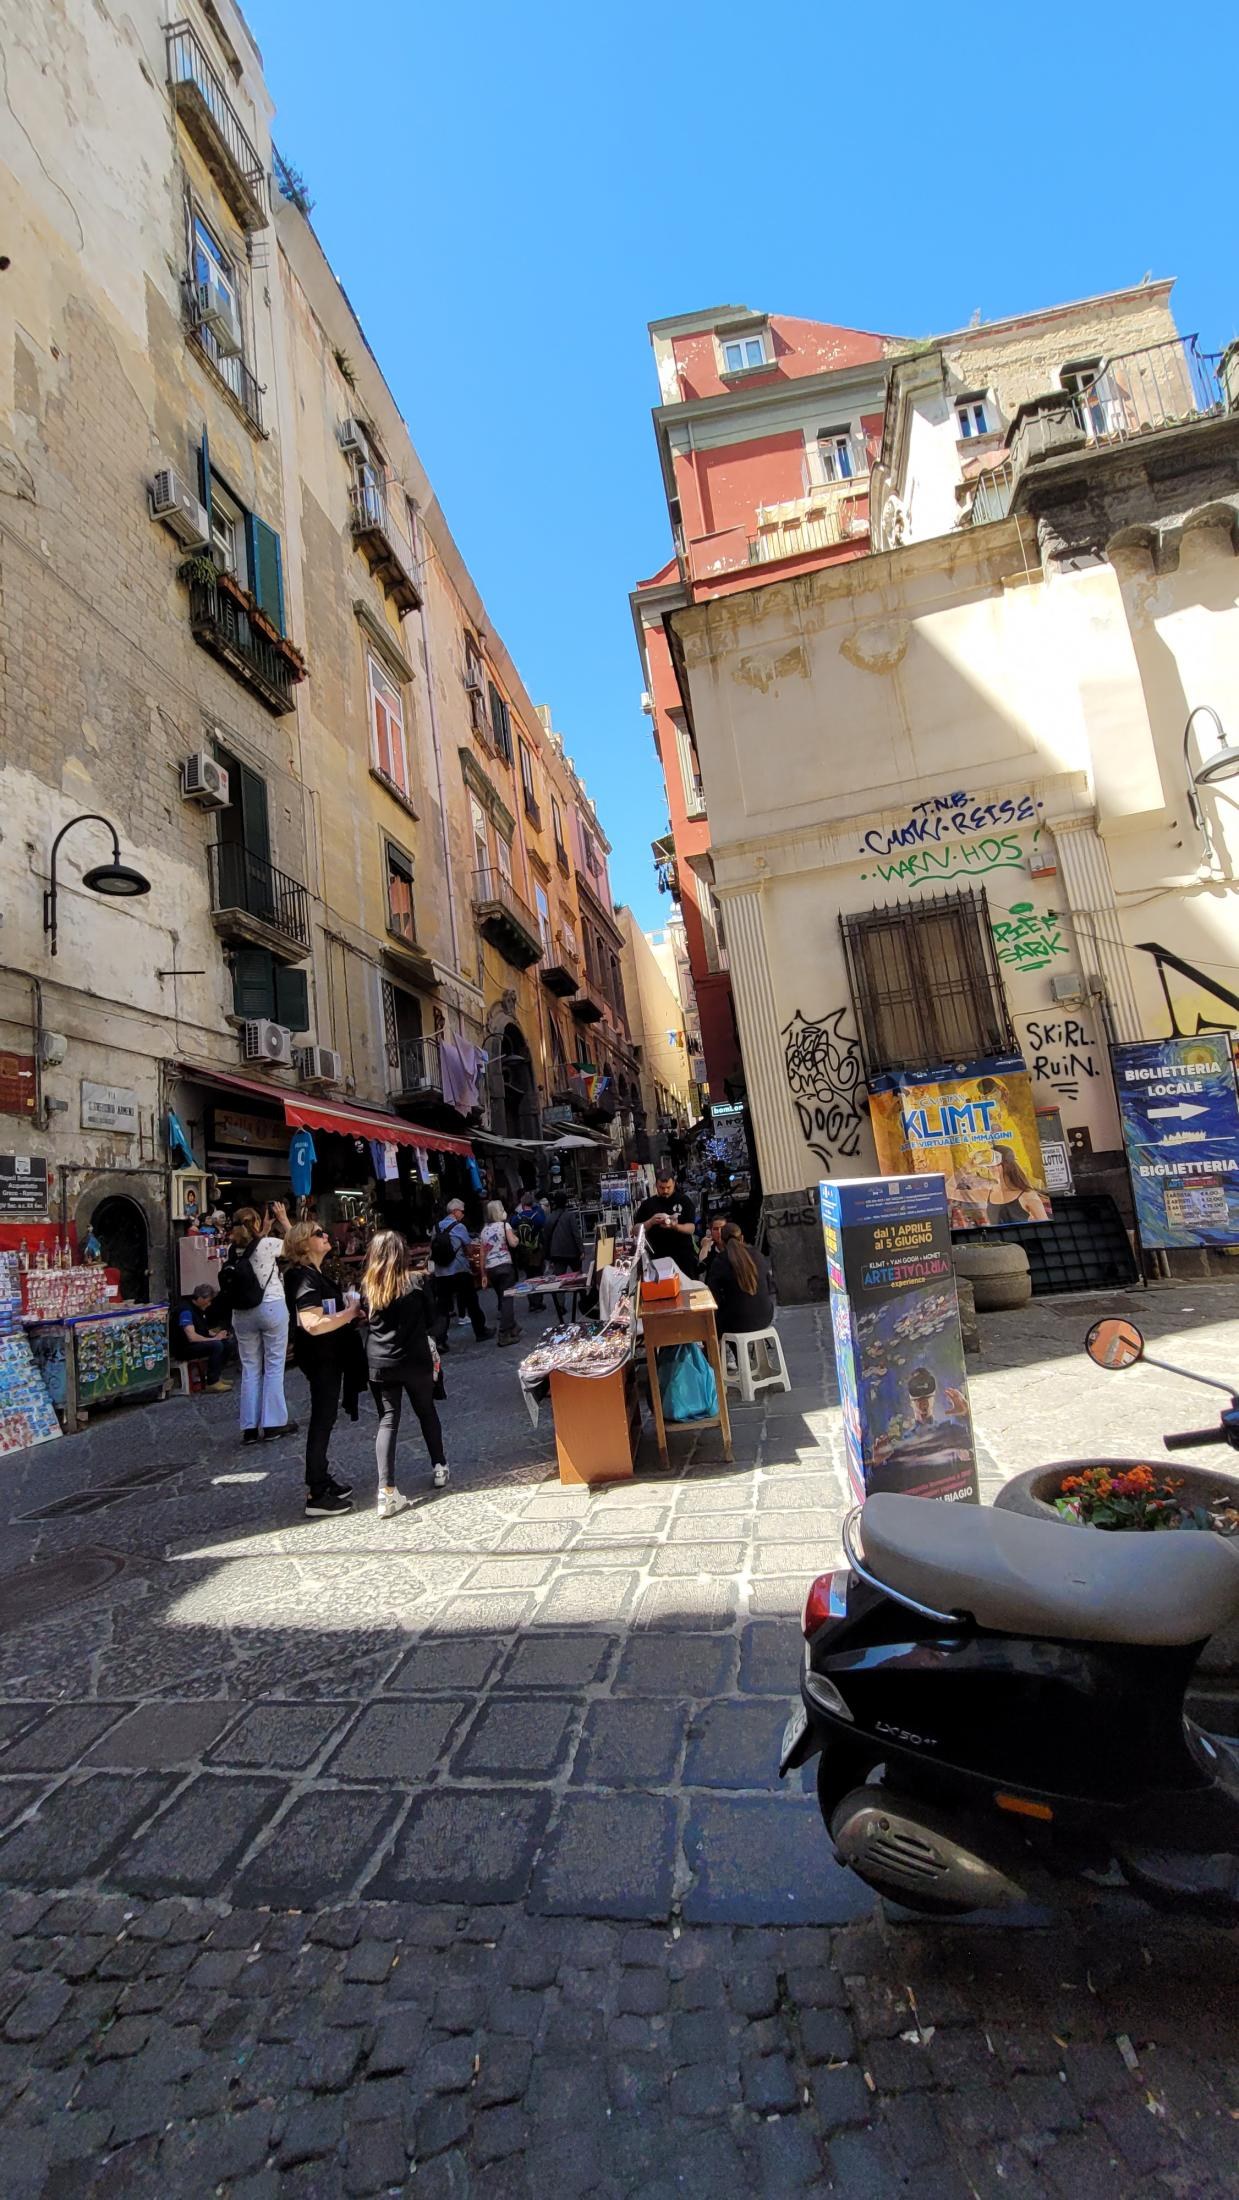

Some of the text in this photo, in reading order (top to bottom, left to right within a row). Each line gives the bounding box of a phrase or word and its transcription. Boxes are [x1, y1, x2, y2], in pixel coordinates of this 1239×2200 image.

[1124, 1061, 1223, 1081] BIGLIETTERIA
[1147, 1081, 1203, 1097] LOCALE
[901, 1100, 996, 1141] KLIMT
[919, 1136, 961, 1148] VIRTUALE
[971, 1131, 1013, 1143] IMMAGINI
[1139, 1159, 1239, 1177] BIGLIETTERIA
[873, 1222, 932, 1239] dal 1 APRILE
[874, 1241, 884, 1250] al
[886, 1239, 893, 1249] 5
[895, 1233, 933, 1248] GIUGNO
[869, 1261, 885, 1269] KLIMT
[890, 1257, 902, 1265] VAN
[903, 1255, 919, 1263] GOGH
[923, 1251, 941, 1260] MONET
[864, 1266, 894, 1285] ARTE
[891, 1277, 926, 1288] experience
[944, 1486, 973, 1502] BIAGIO
